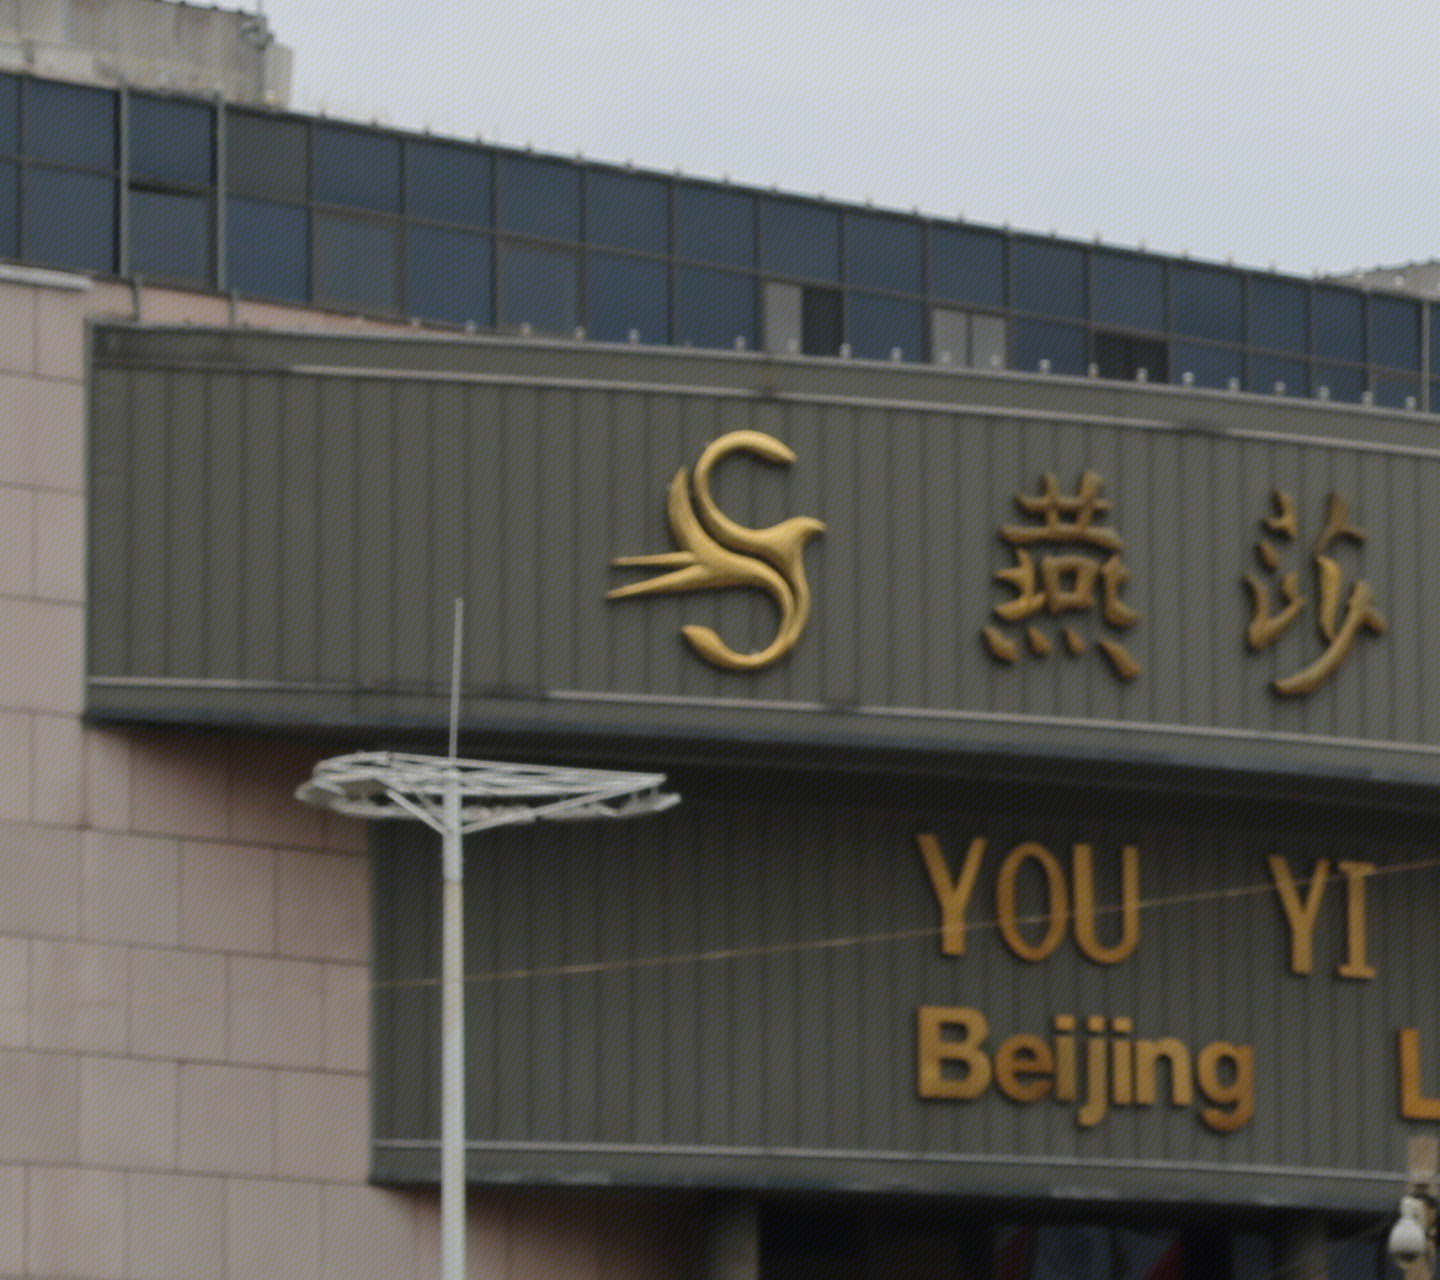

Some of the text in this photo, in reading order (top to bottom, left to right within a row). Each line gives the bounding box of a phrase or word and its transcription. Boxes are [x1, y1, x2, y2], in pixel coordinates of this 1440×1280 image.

[916, 832, 1142, 965] YOU
[1267, 853, 1378, 980] YI
[917, 1004, 1257, 1133] Beijing
